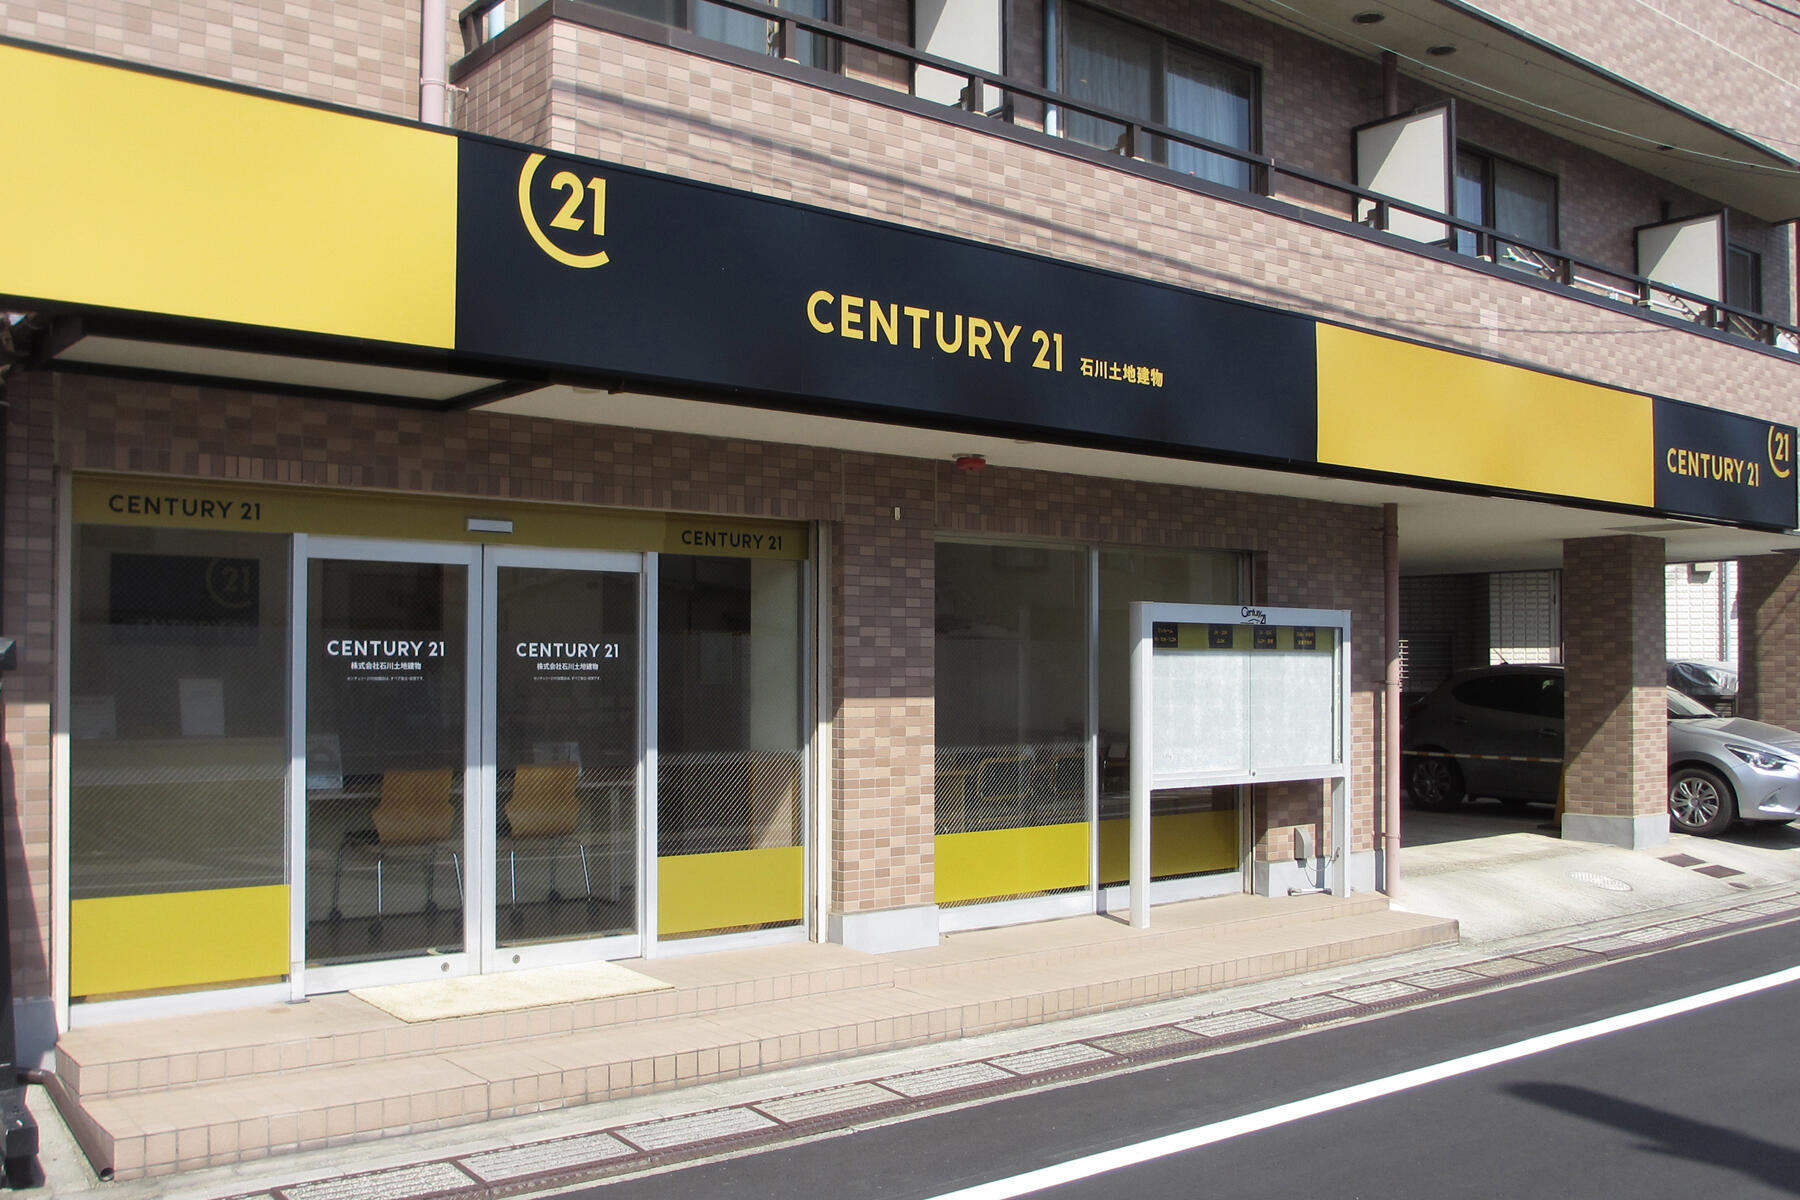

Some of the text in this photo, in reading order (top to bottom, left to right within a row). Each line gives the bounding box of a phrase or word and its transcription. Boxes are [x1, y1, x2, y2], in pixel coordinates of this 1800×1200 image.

[806, 289, 1064, 372] CENTURY 21
[1079, 357, 1164, 388] 石川土地建物
[1667, 447, 1761, 487] CENTURY 21
[109, 494, 262, 521] CENTURY 21
[681, 529, 782, 551] CENTURY 21
[327, 640, 445, 657] CENTURY 21
[516, 642, 619, 658] CENTURY 21
[350, 661, 422, 670] 株式会社石川土地建物
[536, 662, 599, 671] 株式会社石川土地建物
